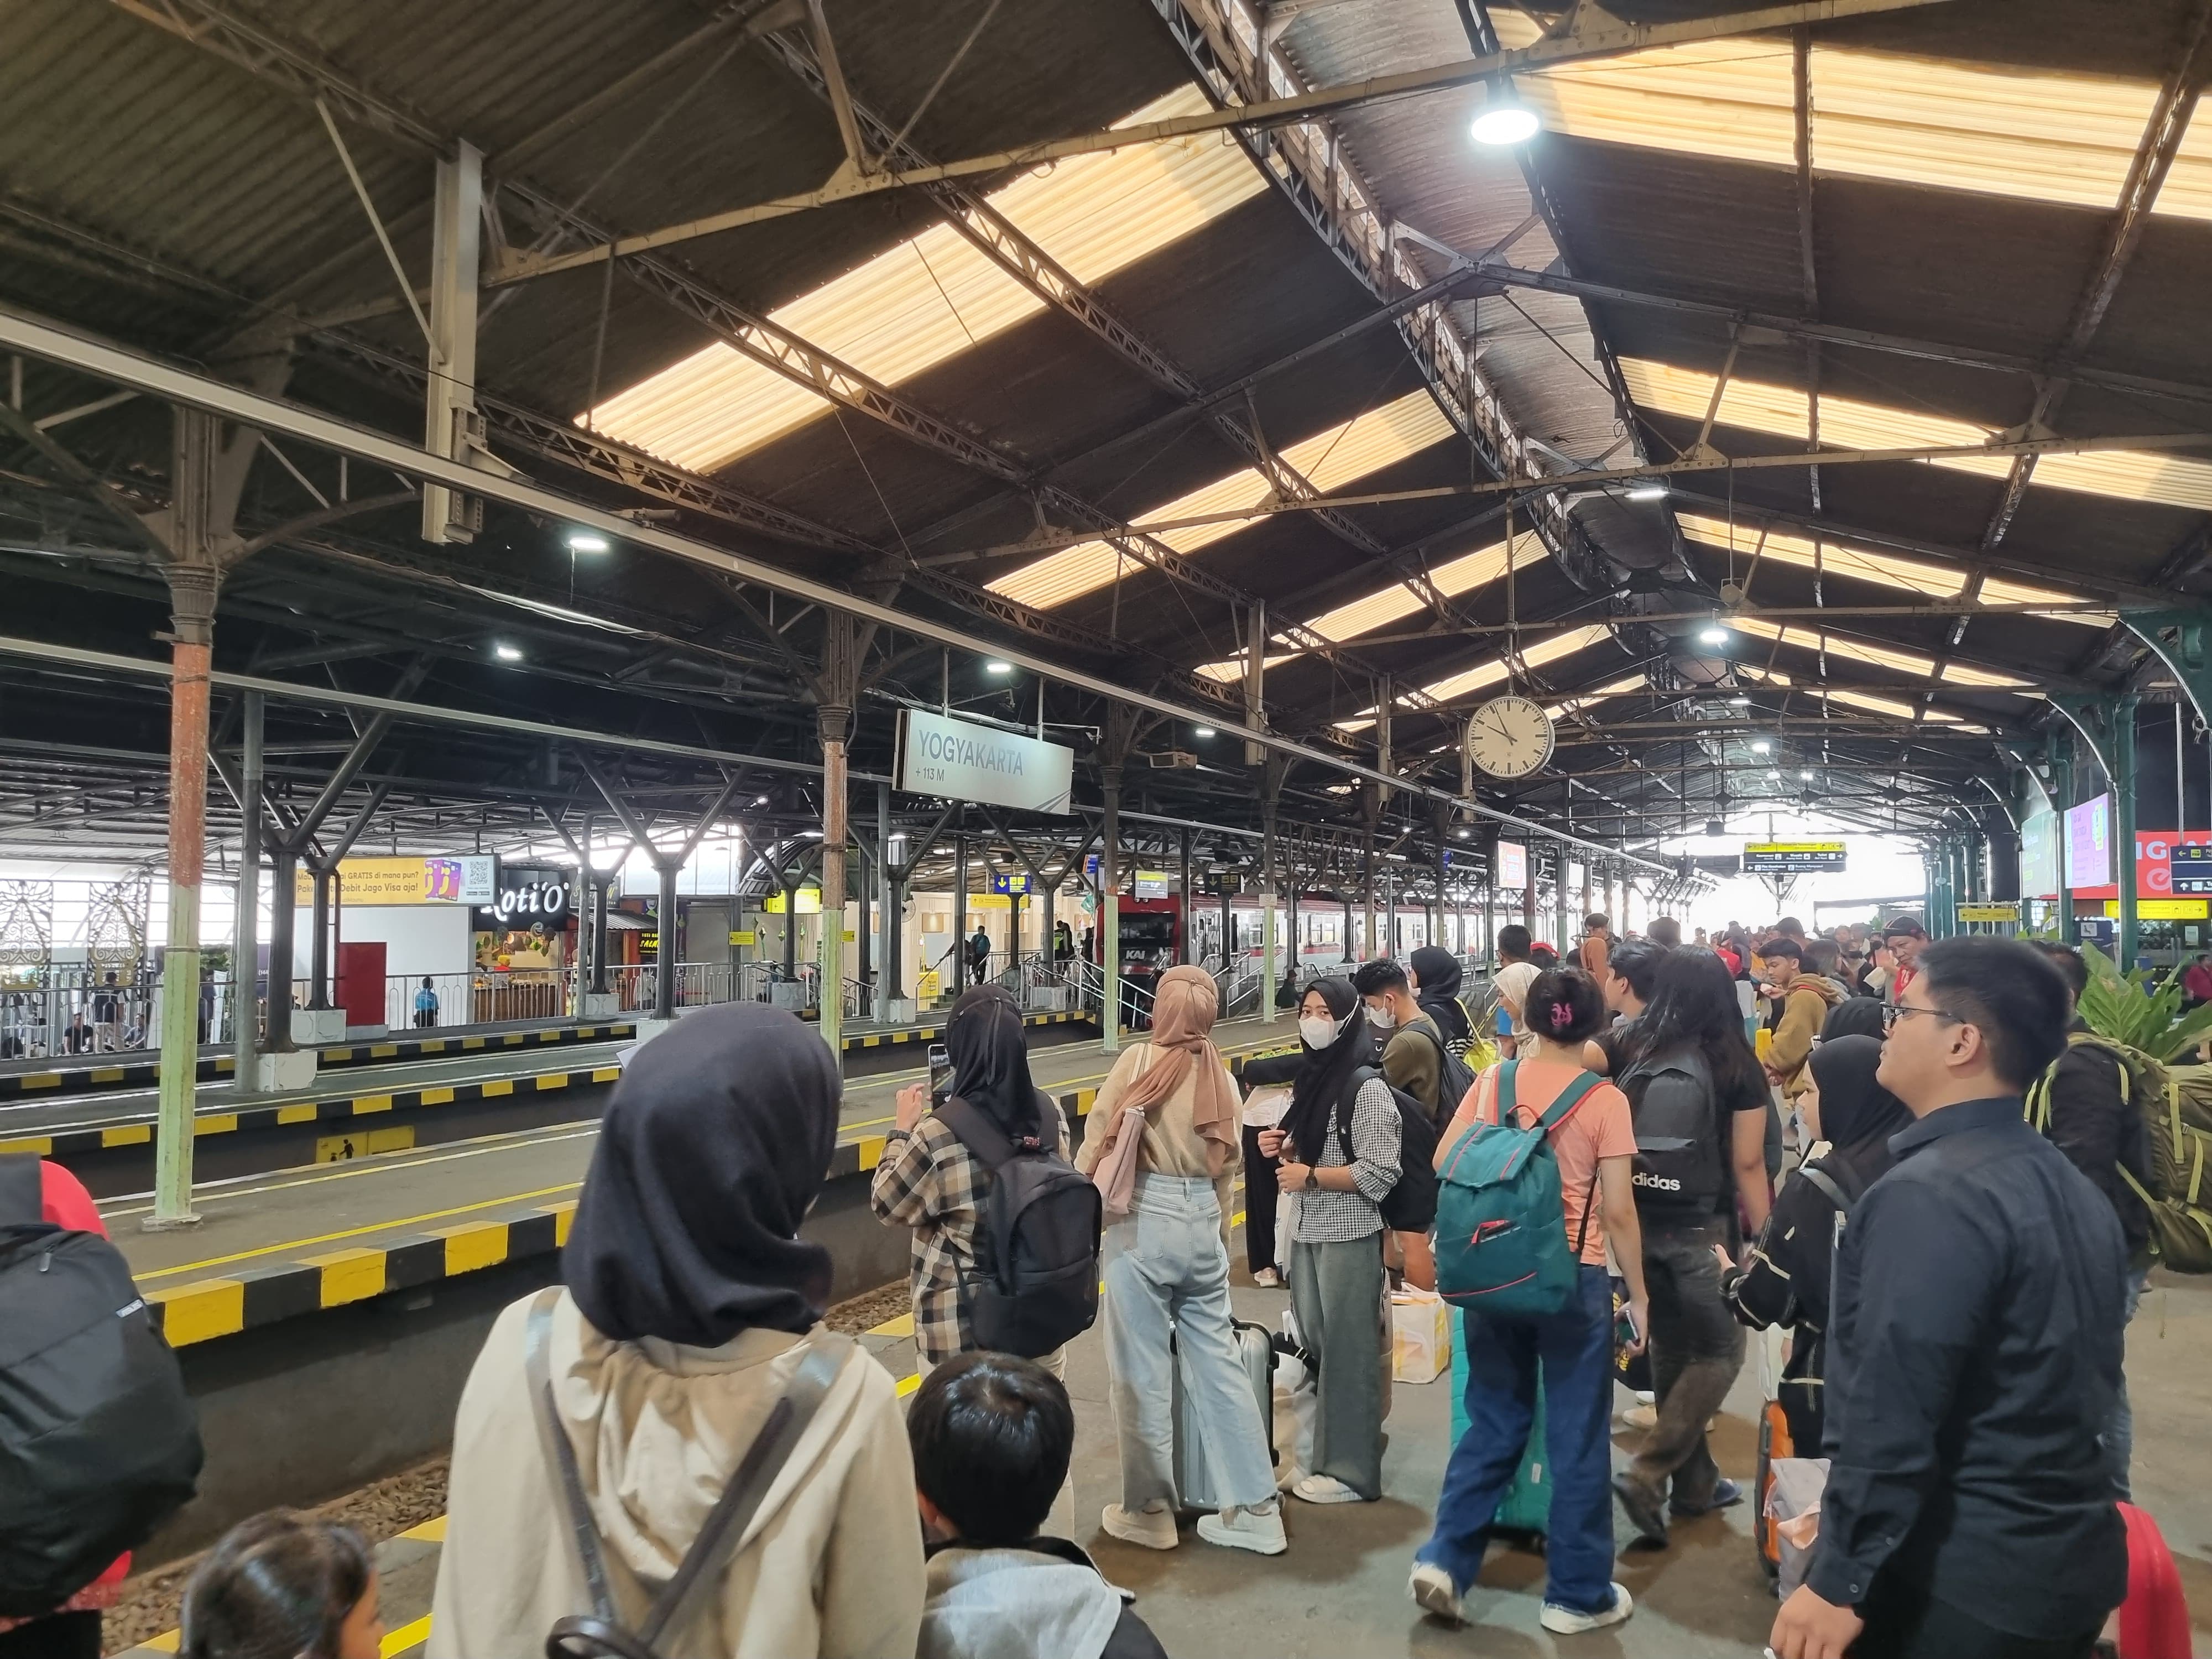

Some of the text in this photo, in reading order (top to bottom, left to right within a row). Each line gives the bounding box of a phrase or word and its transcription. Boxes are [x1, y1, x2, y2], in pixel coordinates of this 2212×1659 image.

[919, 729, 1023, 776] YOGYAKARTA
[924, 767, 935, 780] 113
[936, 769, 945, 782] M
[403, 871, 419, 880] pun?
[341, 884, 361, 892] Debit
[363, 884, 382, 893] Jago
[384, 883, 401, 891] Visa
[403, 883, 418, 893] aja!
[1125, 950, 1146, 959] KAI
[1632, 1172, 1681, 1191] adidas
